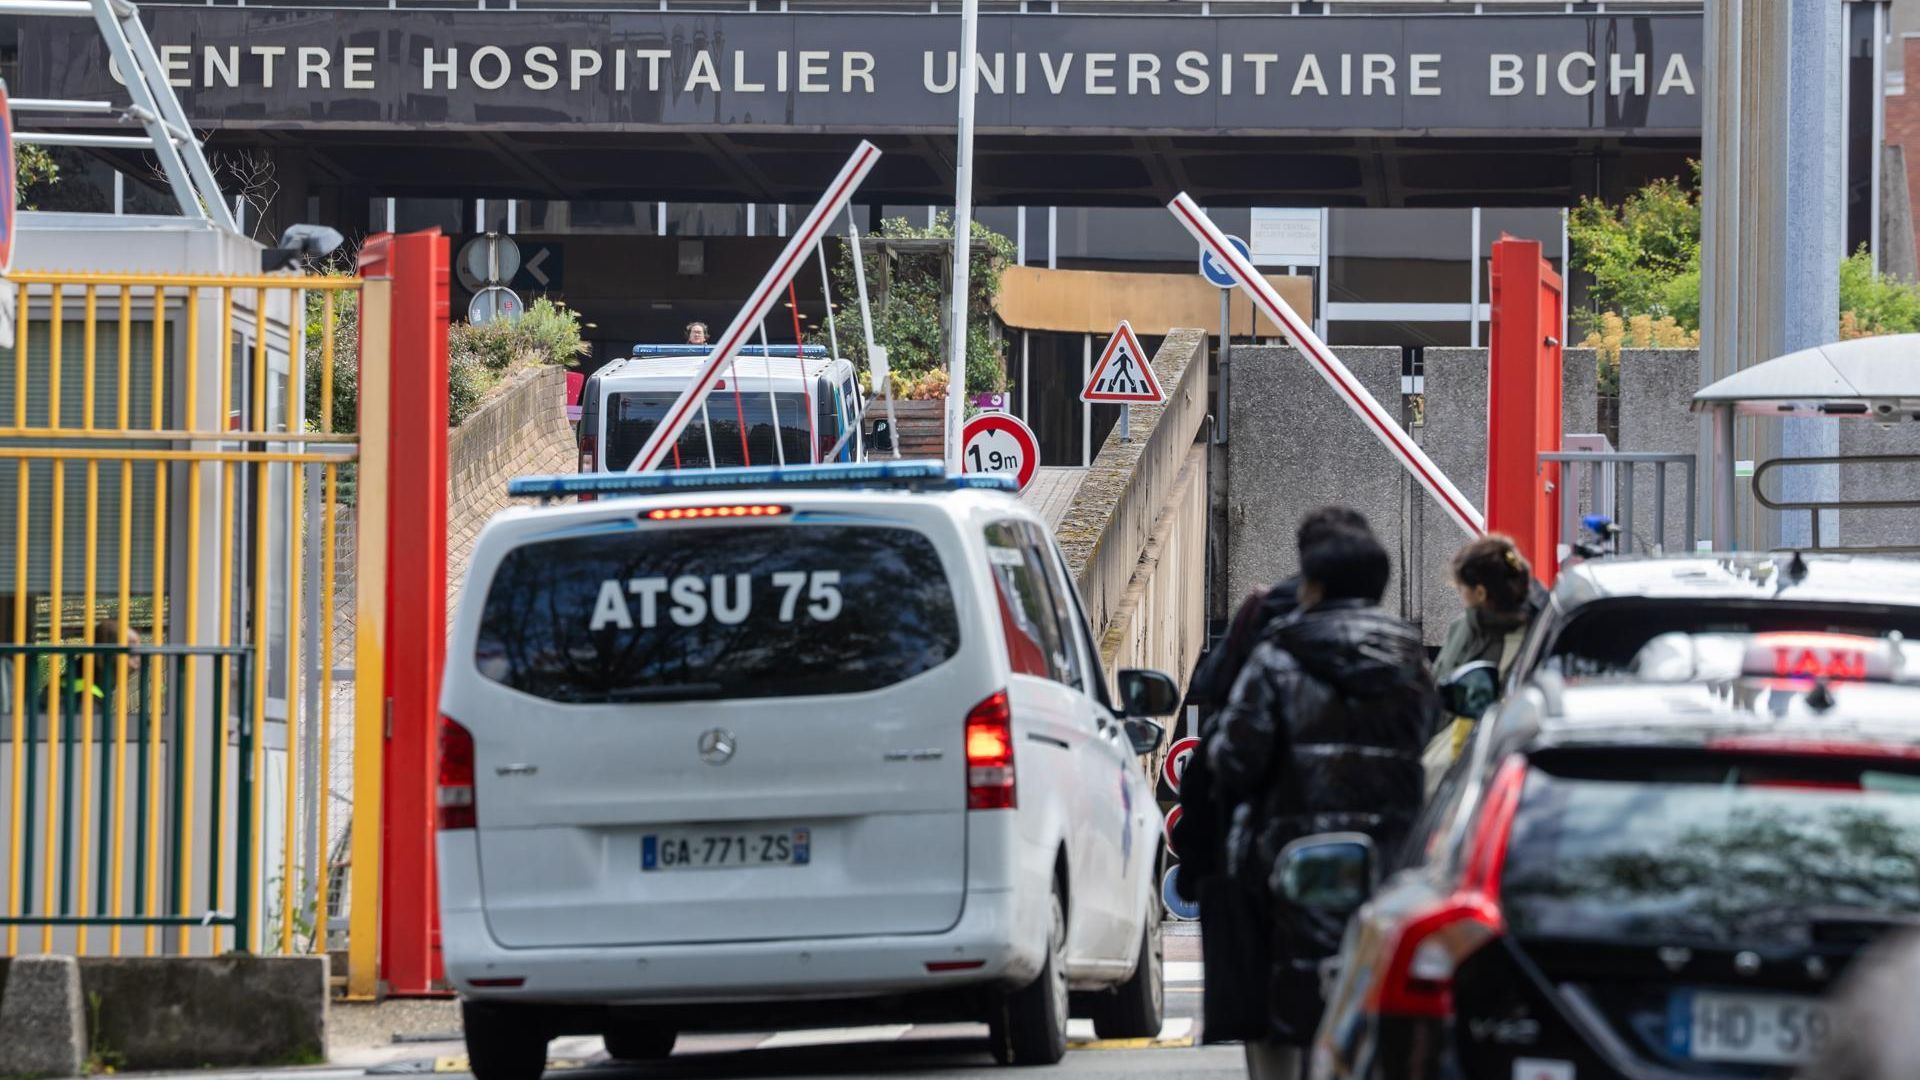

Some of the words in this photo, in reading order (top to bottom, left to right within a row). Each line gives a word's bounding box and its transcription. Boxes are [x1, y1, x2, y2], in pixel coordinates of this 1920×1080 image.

[423, 45, 876, 93] HOSPITALIER
[923, 50, 1442, 96] UNIVERSITAIRE
[589, 574, 752, 631] ATSU
[771, 570, 843, 622] 75
[1771, 646, 1866, 680] TAXI
[661, 834, 790, 866] GA-771-ZS
